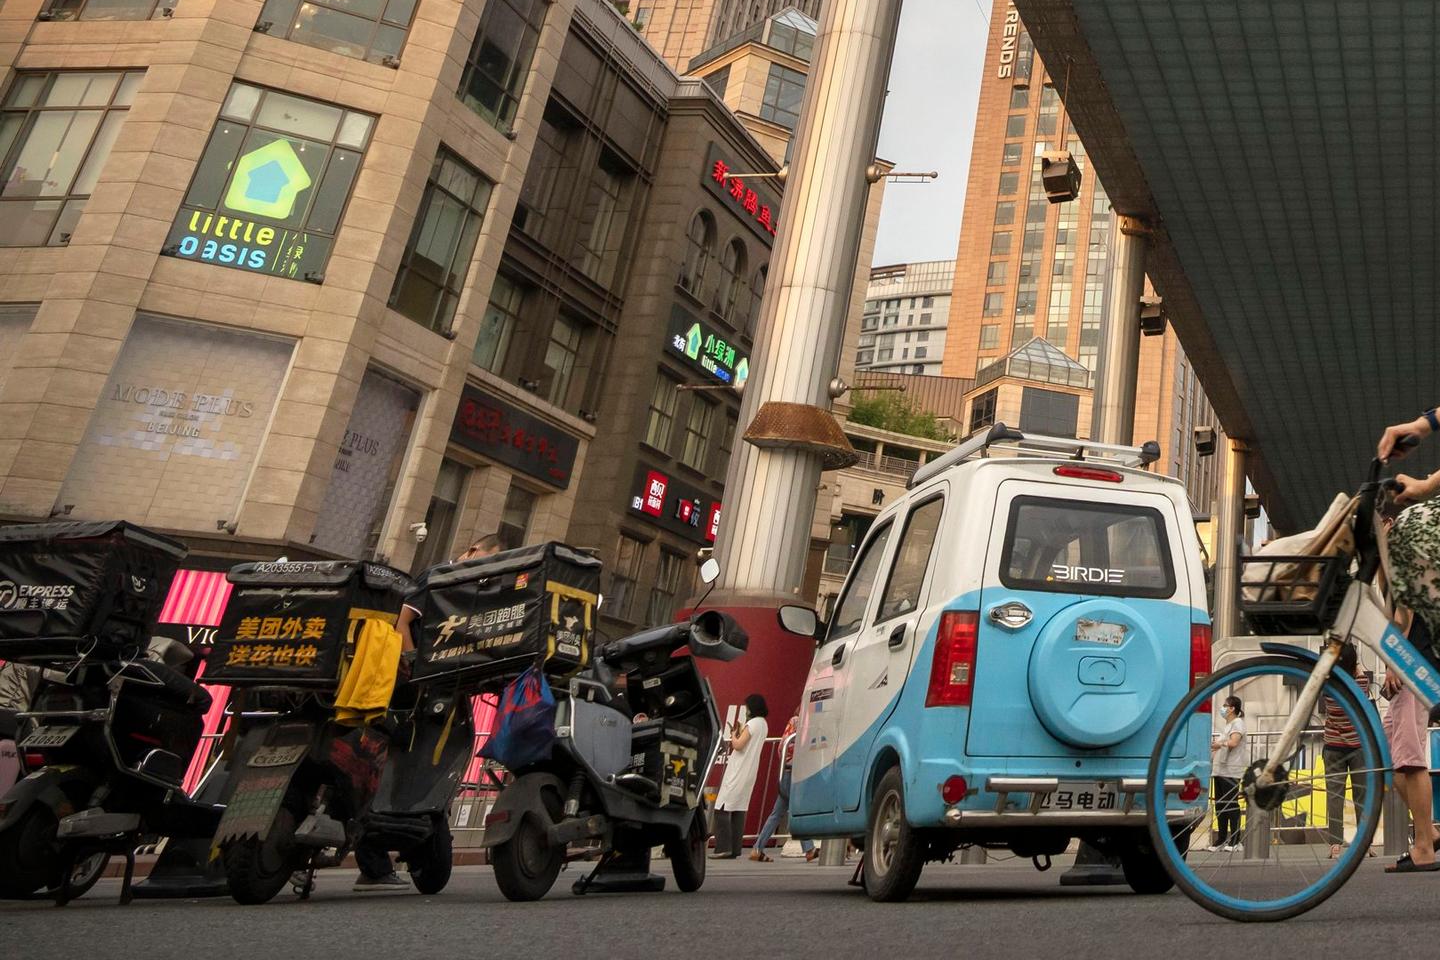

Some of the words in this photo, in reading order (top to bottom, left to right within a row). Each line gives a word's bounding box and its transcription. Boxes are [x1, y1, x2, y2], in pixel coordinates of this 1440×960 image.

[711, 159, 777, 237] 新沸腾鱼
[188, 210, 276, 246] little
[178, 236, 267, 269] oasis
[111, 383, 188, 410] MODE
[192, 393, 256, 418] PLUS
[147, 421, 200, 438] BEIJING
[349, 432, 380, 457] PLUS
[1052, 564, 1126, 583] BIRDIE
[19, 584, 76, 598] EXPRESS
[235, 616, 327, 640] 美团外卖
[224, 643, 318, 667] 送花也快
